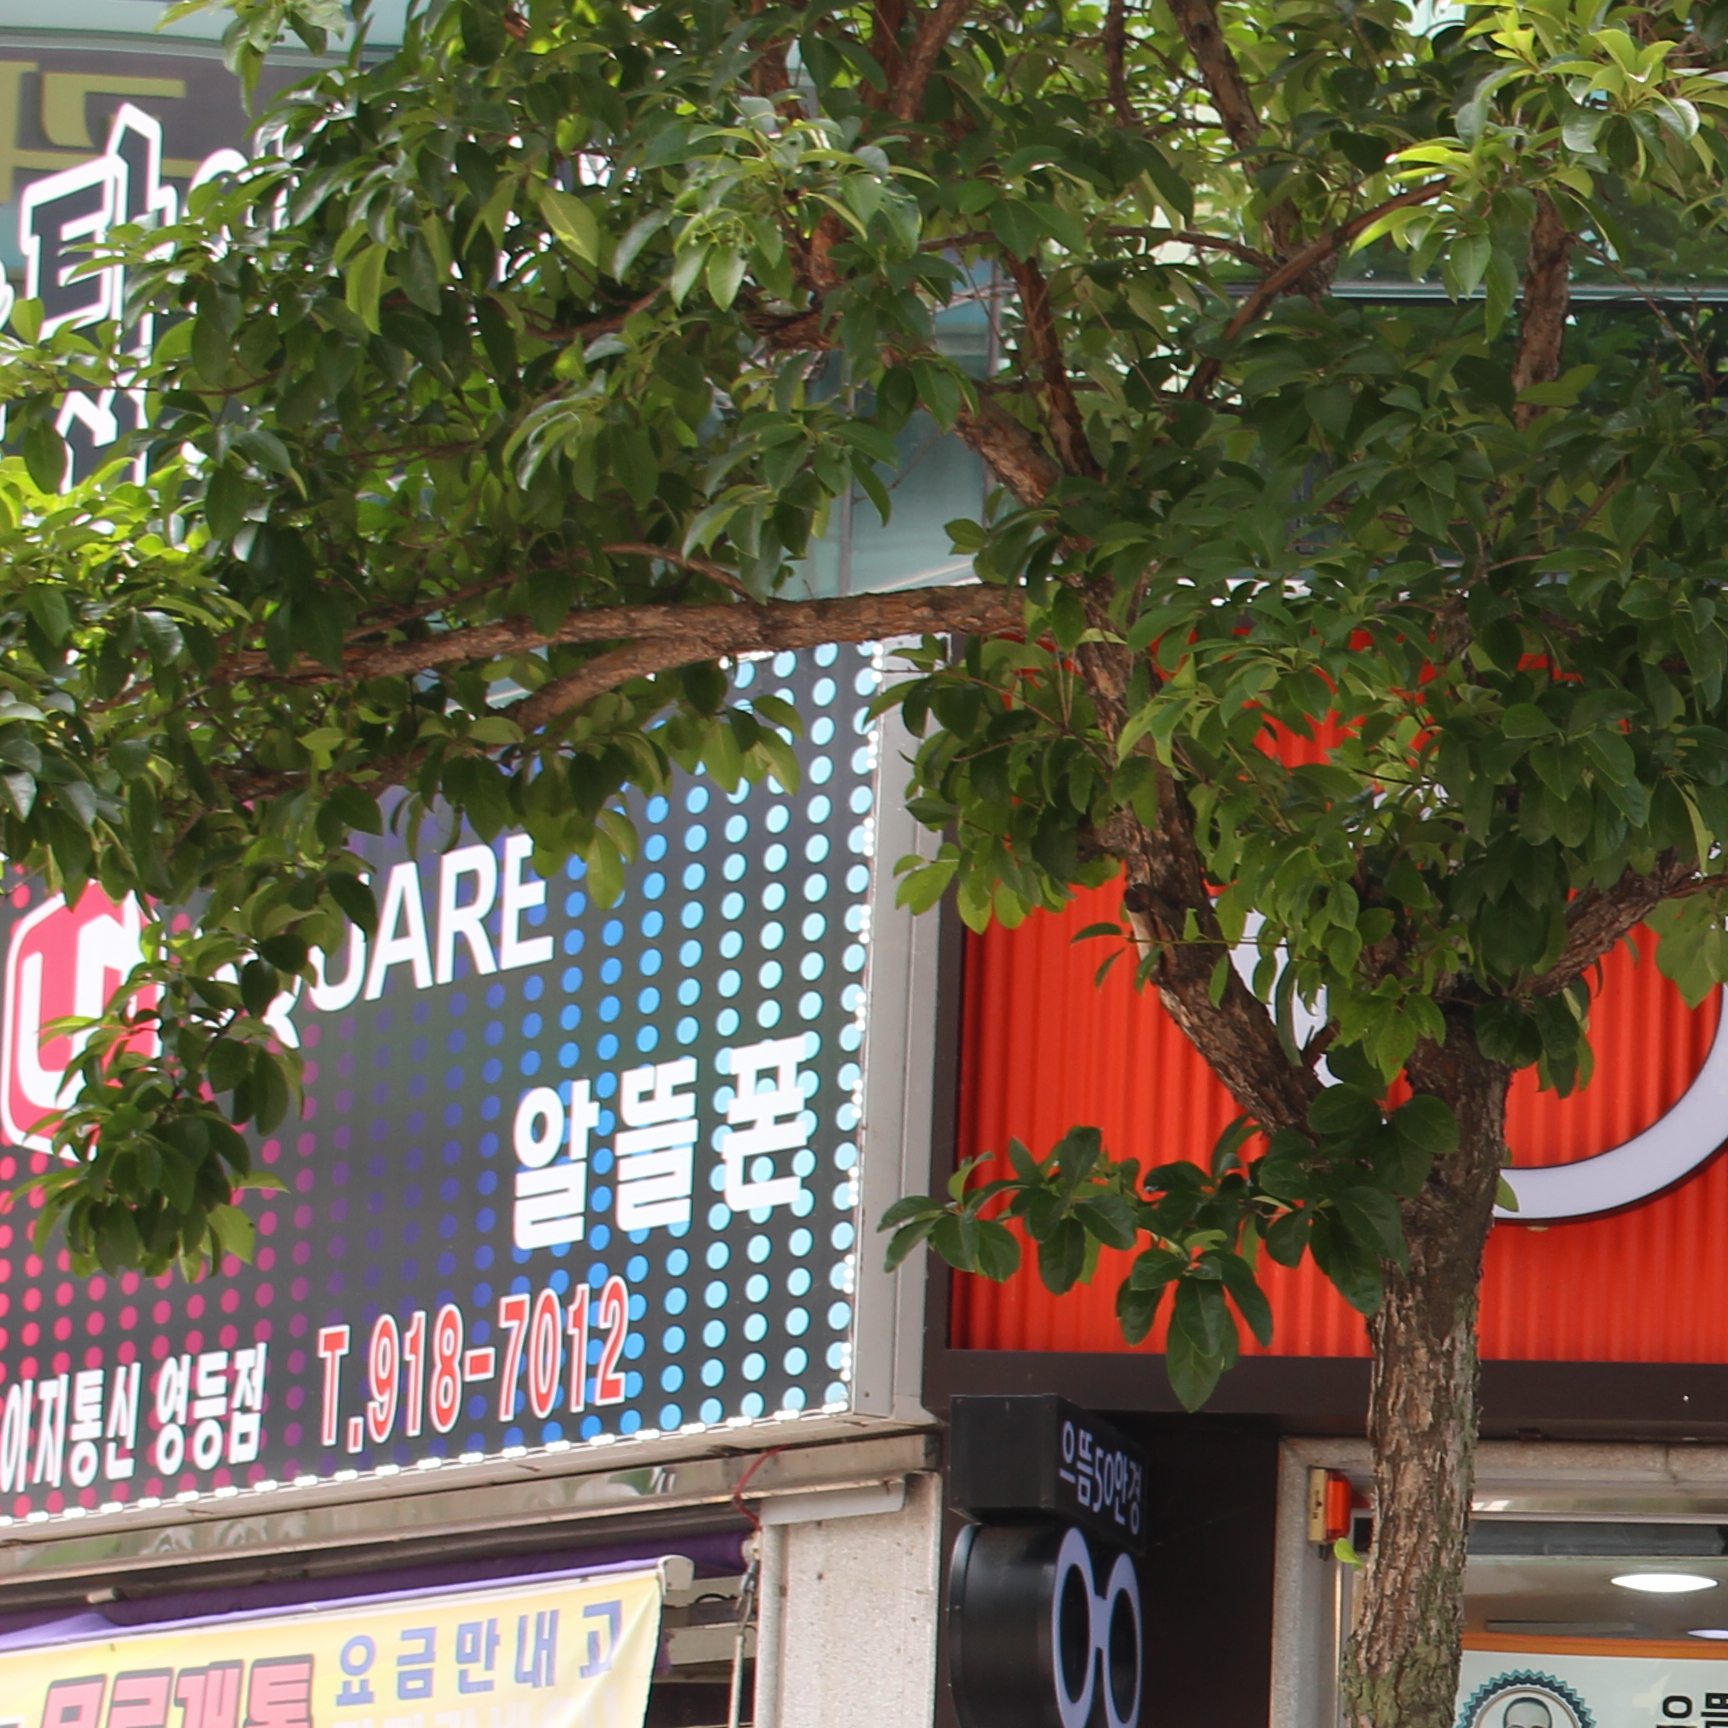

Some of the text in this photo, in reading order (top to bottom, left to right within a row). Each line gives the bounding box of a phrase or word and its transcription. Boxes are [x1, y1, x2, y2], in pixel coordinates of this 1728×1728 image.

[513, 1034, 808, 1252] 알뜰폰
[155, 1342, 268, 1477] 영등점
[317, 1273, 630, 1454] T.918-7012
[1059, 1420, 1140, 1536] 으뜸50안경
